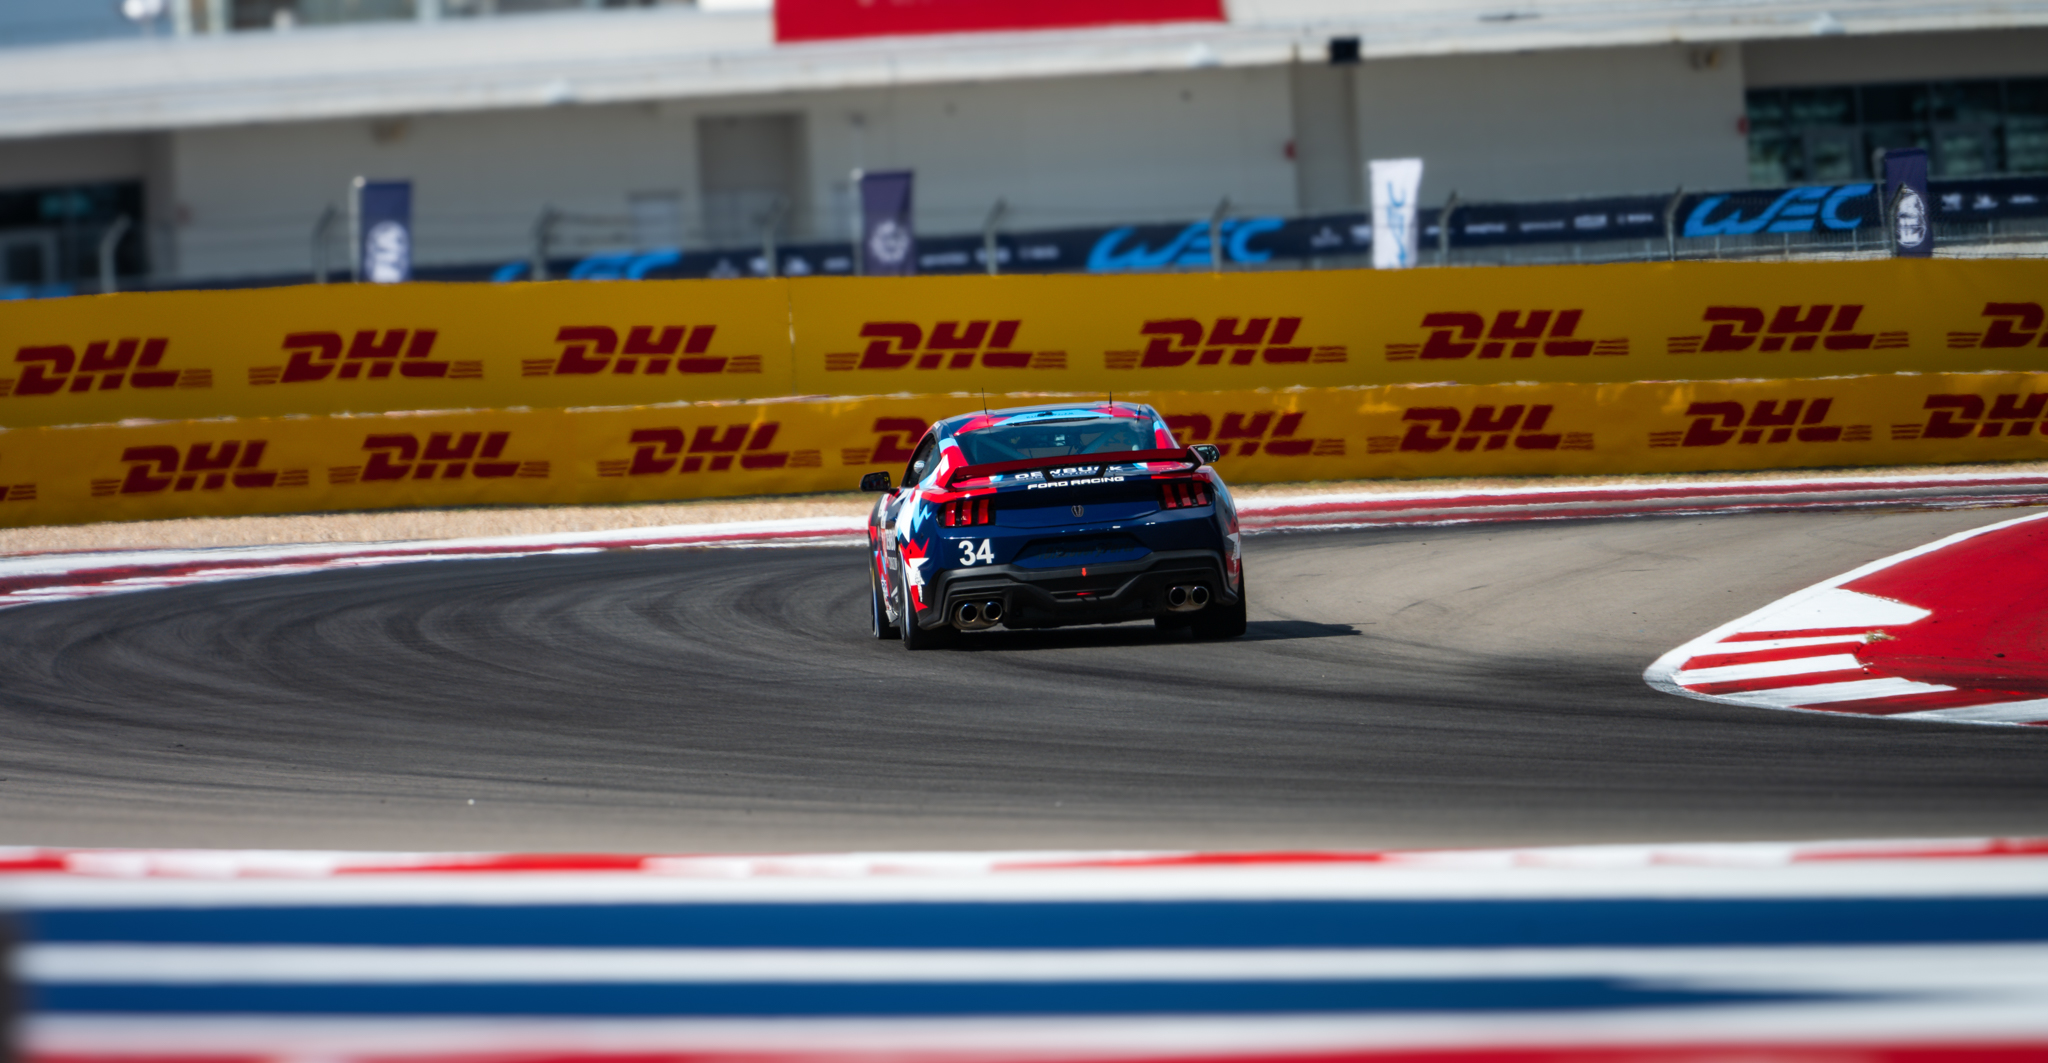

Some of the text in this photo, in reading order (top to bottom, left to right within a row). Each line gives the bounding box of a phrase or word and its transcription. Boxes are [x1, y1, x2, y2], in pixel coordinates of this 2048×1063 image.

[1683, 183, 1875, 237] WEC
[1086, 217, 1286, 272] WEC
[555, 325, 727, 376] DHL
[858, 320, 1033, 370] DHL
[1140, 316, 1312, 368] DHL
[1419, 309, 1595, 360] DHL
[1701, 304, 1875, 354] DHL
[14, 338, 180, 396] DHL
[280, 328, 450, 385] DHL
[1399, 404, 1562, 452] DHL
[1682, 397, 1843, 448] DHL
[1922, 393, 2048, 439] DH
[120, 440, 278, 494] DHL
[360, 431, 520, 483] DHL
[628, 422, 790, 476] DHL
[1027, 480, 1068, 490] FORD
[1070, 476, 1125, 486] RACING
[958, 538, 995, 567] 34
